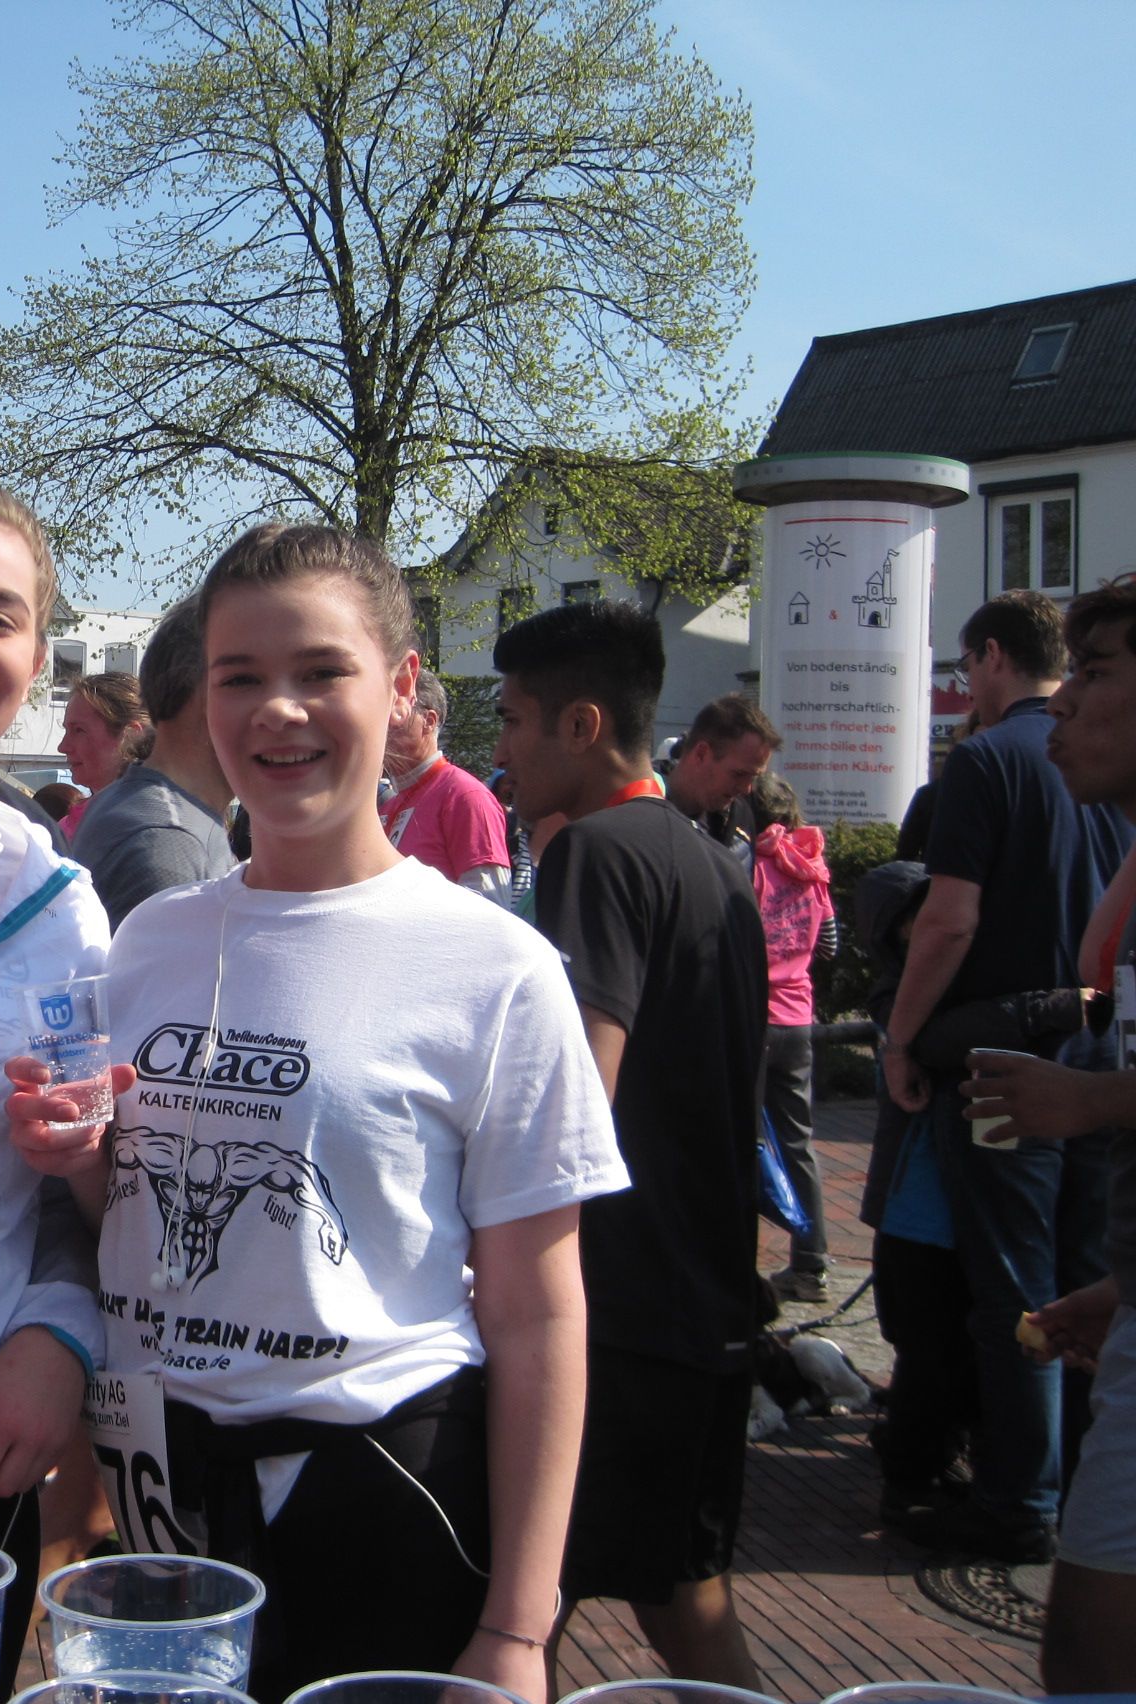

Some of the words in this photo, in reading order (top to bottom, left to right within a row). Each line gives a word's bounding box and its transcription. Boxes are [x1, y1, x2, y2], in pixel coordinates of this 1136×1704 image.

[787, 662, 807, 672] Von
[810, 662, 897, 675] bodenständig
[830, 681, 850, 692] bis
[804, 723, 827, 731] uns
[859, 742, 883, 752] den
[139, 1091, 282, 1121] KALTENKIRCHEN
[174, 1316, 250, 1351] TRAIN
[109, 1379, 126, 1404] AG
[97, 1413, 114, 1427] zum
[115, 1412, 130, 1428] Ziel
